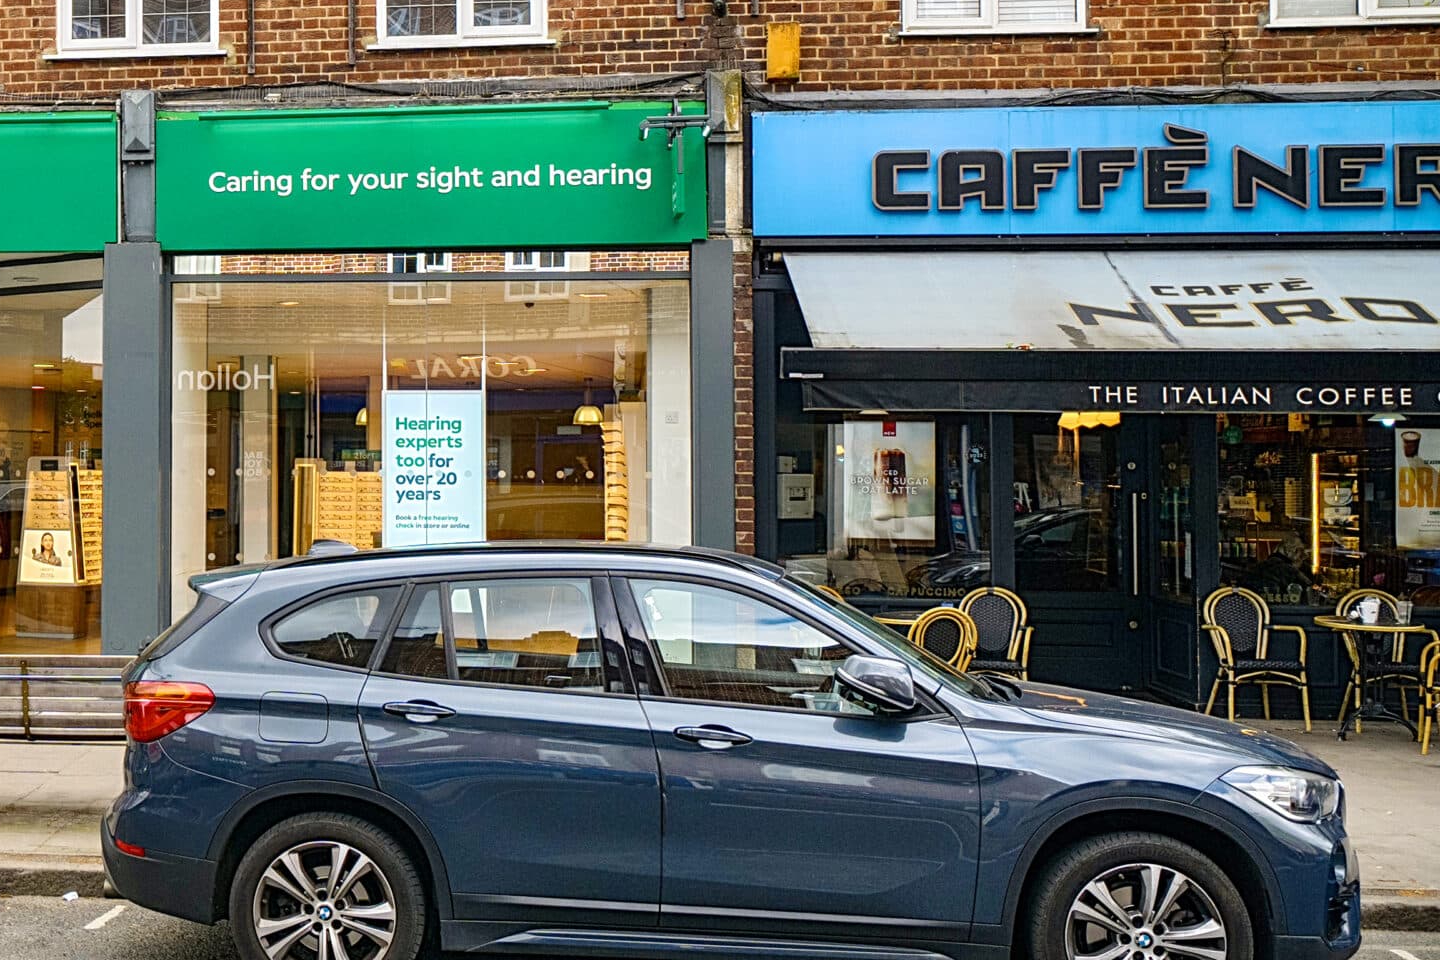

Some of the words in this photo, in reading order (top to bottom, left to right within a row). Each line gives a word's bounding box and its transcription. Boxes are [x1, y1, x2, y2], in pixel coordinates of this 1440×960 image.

[871, 123, 1210, 212] CAFFÈ
[208, 171, 293, 196] Caring
[300, 168, 340, 191] for
[348, 170, 409, 195] your
[416, 165, 483, 194] sight
[491, 164, 541, 188] and
[548, 163, 652, 190] hearing
[1149, 278, 1314, 297] CAFFÈ
[1065, 296, 1440, 328] NERO
[1089, 385, 1139, 404] THE
[1162, 386, 1272, 405] ITALIAN
[1295, 387, 1413, 406] COFFEE
[395, 416, 462, 434] Hearing
[395, 436, 463, 451] experts
[395, 454, 425, 467] too
[428, 453, 454, 468] for
[395, 474, 433, 485] over
[436, 472, 457, 485] 20
[850, 477, 890, 486] BROWN
[893, 477, 929, 486] SUGAR
[395, 489, 441, 504] years
[861, 486, 882, 494] OAT
[885, 486, 918, 495] LATTE
[432, 514, 459, 522] hearing
